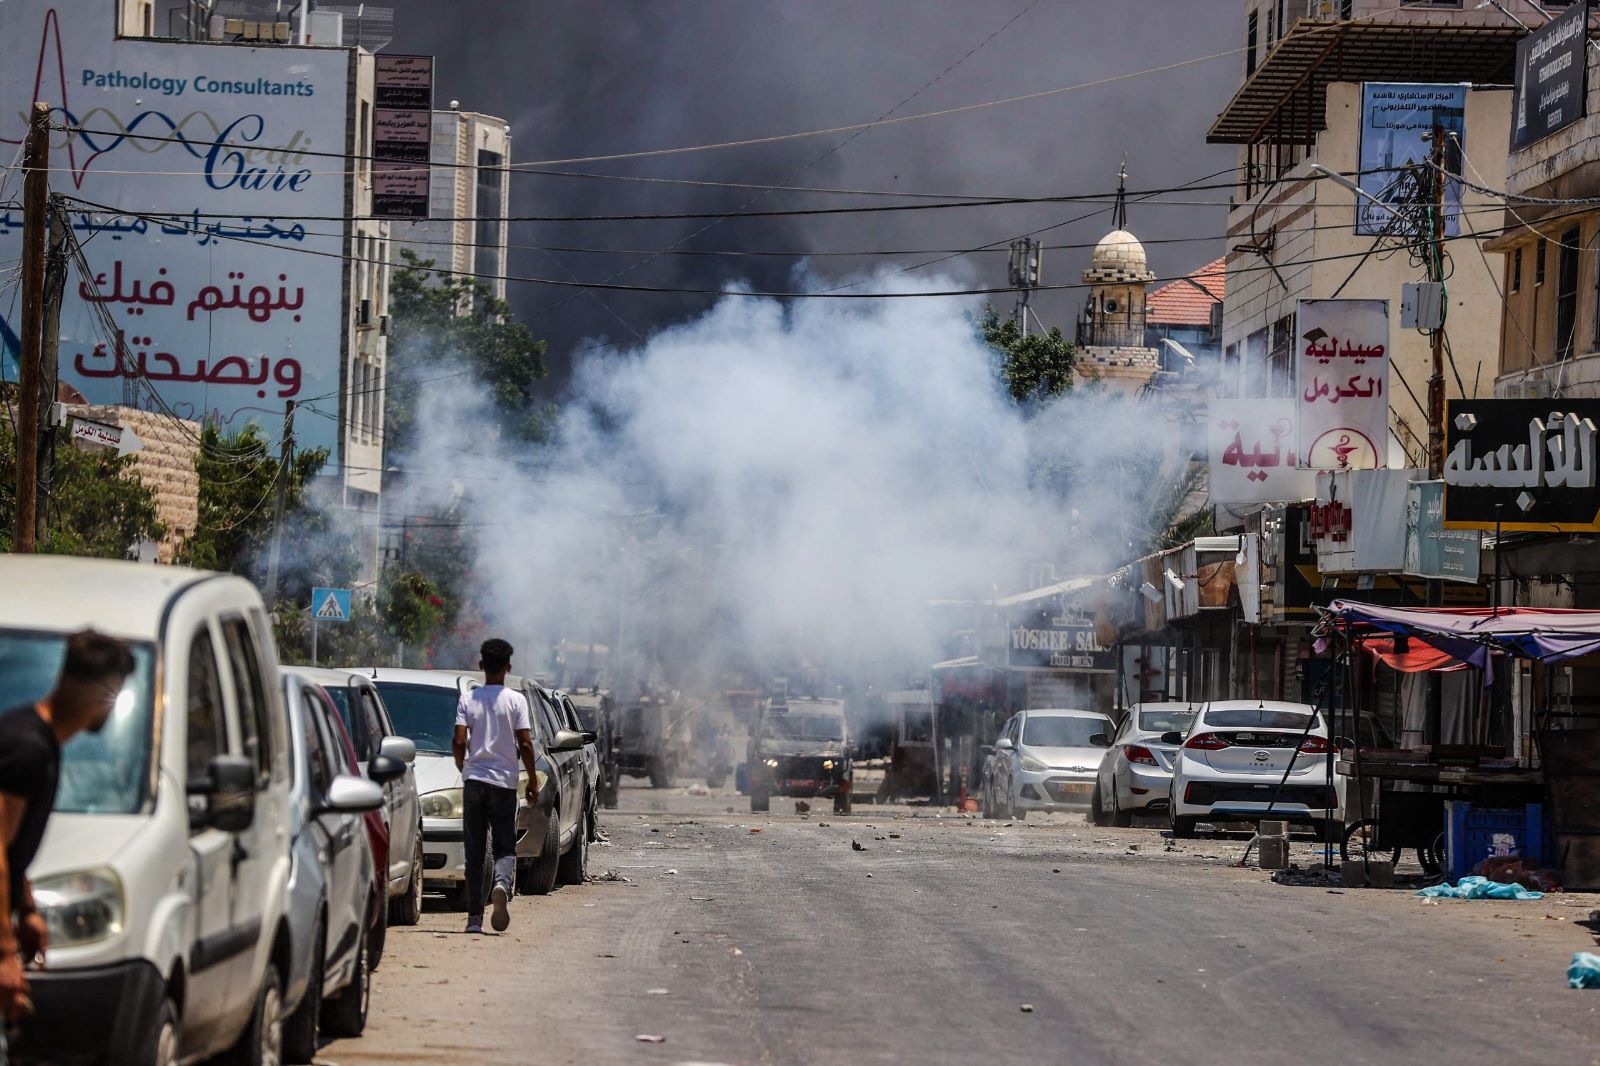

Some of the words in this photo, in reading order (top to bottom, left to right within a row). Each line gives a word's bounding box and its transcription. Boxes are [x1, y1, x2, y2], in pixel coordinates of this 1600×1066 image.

[82, 69, 187, 96] Pathology
[193, 75, 314, 97] Consultants
[1435, 91, 1454, 100] المركز
[204, 114, 312, 193] Care
[162, 208, 305, 246] مختبرات
[79, 261, 175, 315] فيك
[187, 272, 304, 322] بنهتم
[74, 329, 302, 398] وبصحتك
[1304, 375, 1382, 403] الكرمل
[1443, 411, 1598, 512] للألبسة
[1076, 631, 1111, 652] SAL
